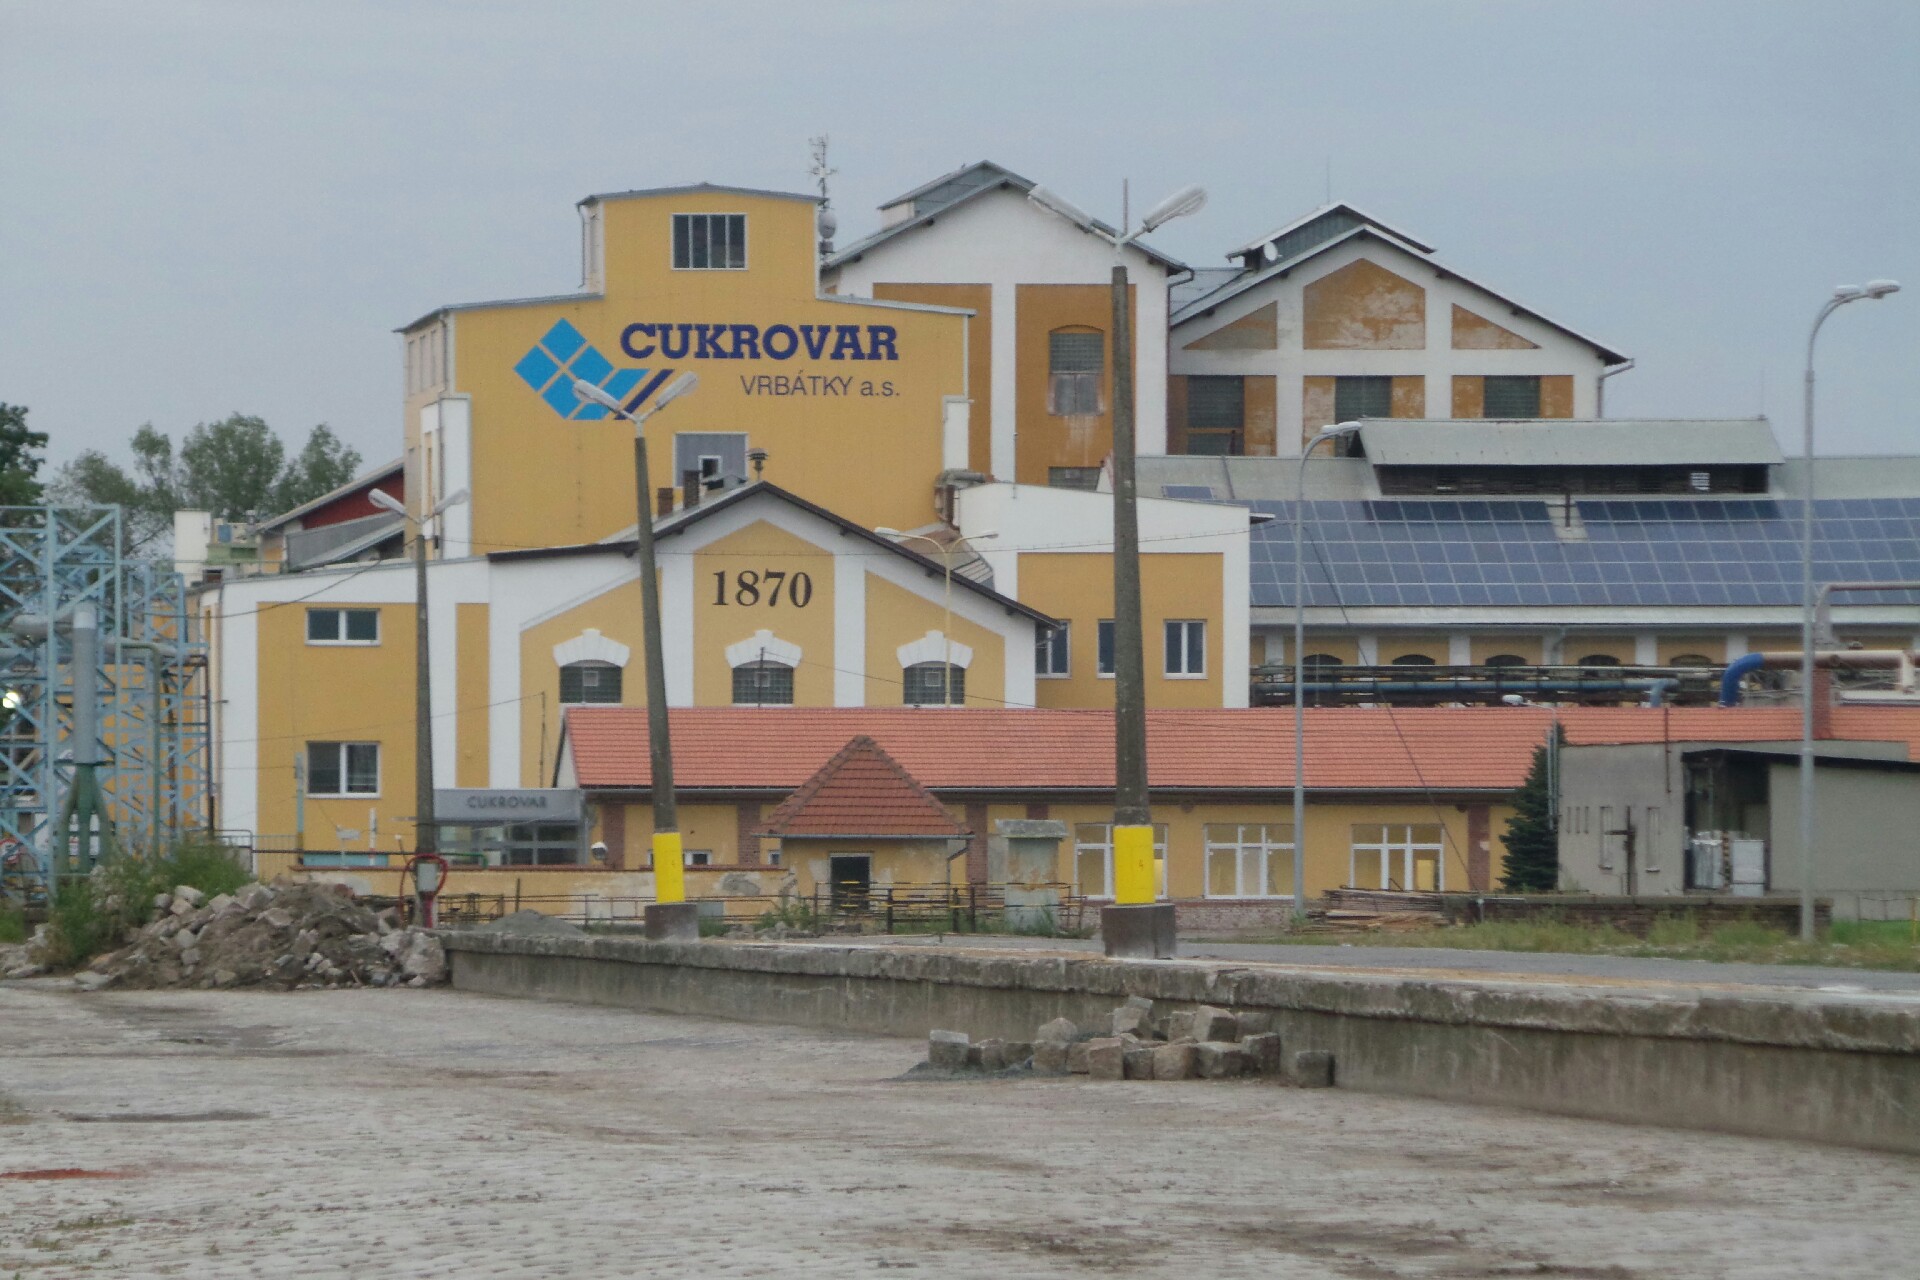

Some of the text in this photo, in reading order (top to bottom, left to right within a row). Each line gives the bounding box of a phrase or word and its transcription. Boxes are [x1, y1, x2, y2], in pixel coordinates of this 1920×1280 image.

[620, 322, 899, 361] CUKROVAR
[740, 370, 900, 397] VRBÁTKY a.s.
[712, 569, 812, 608] 1870
[467, 795, 547, 809] CUKROVAR
